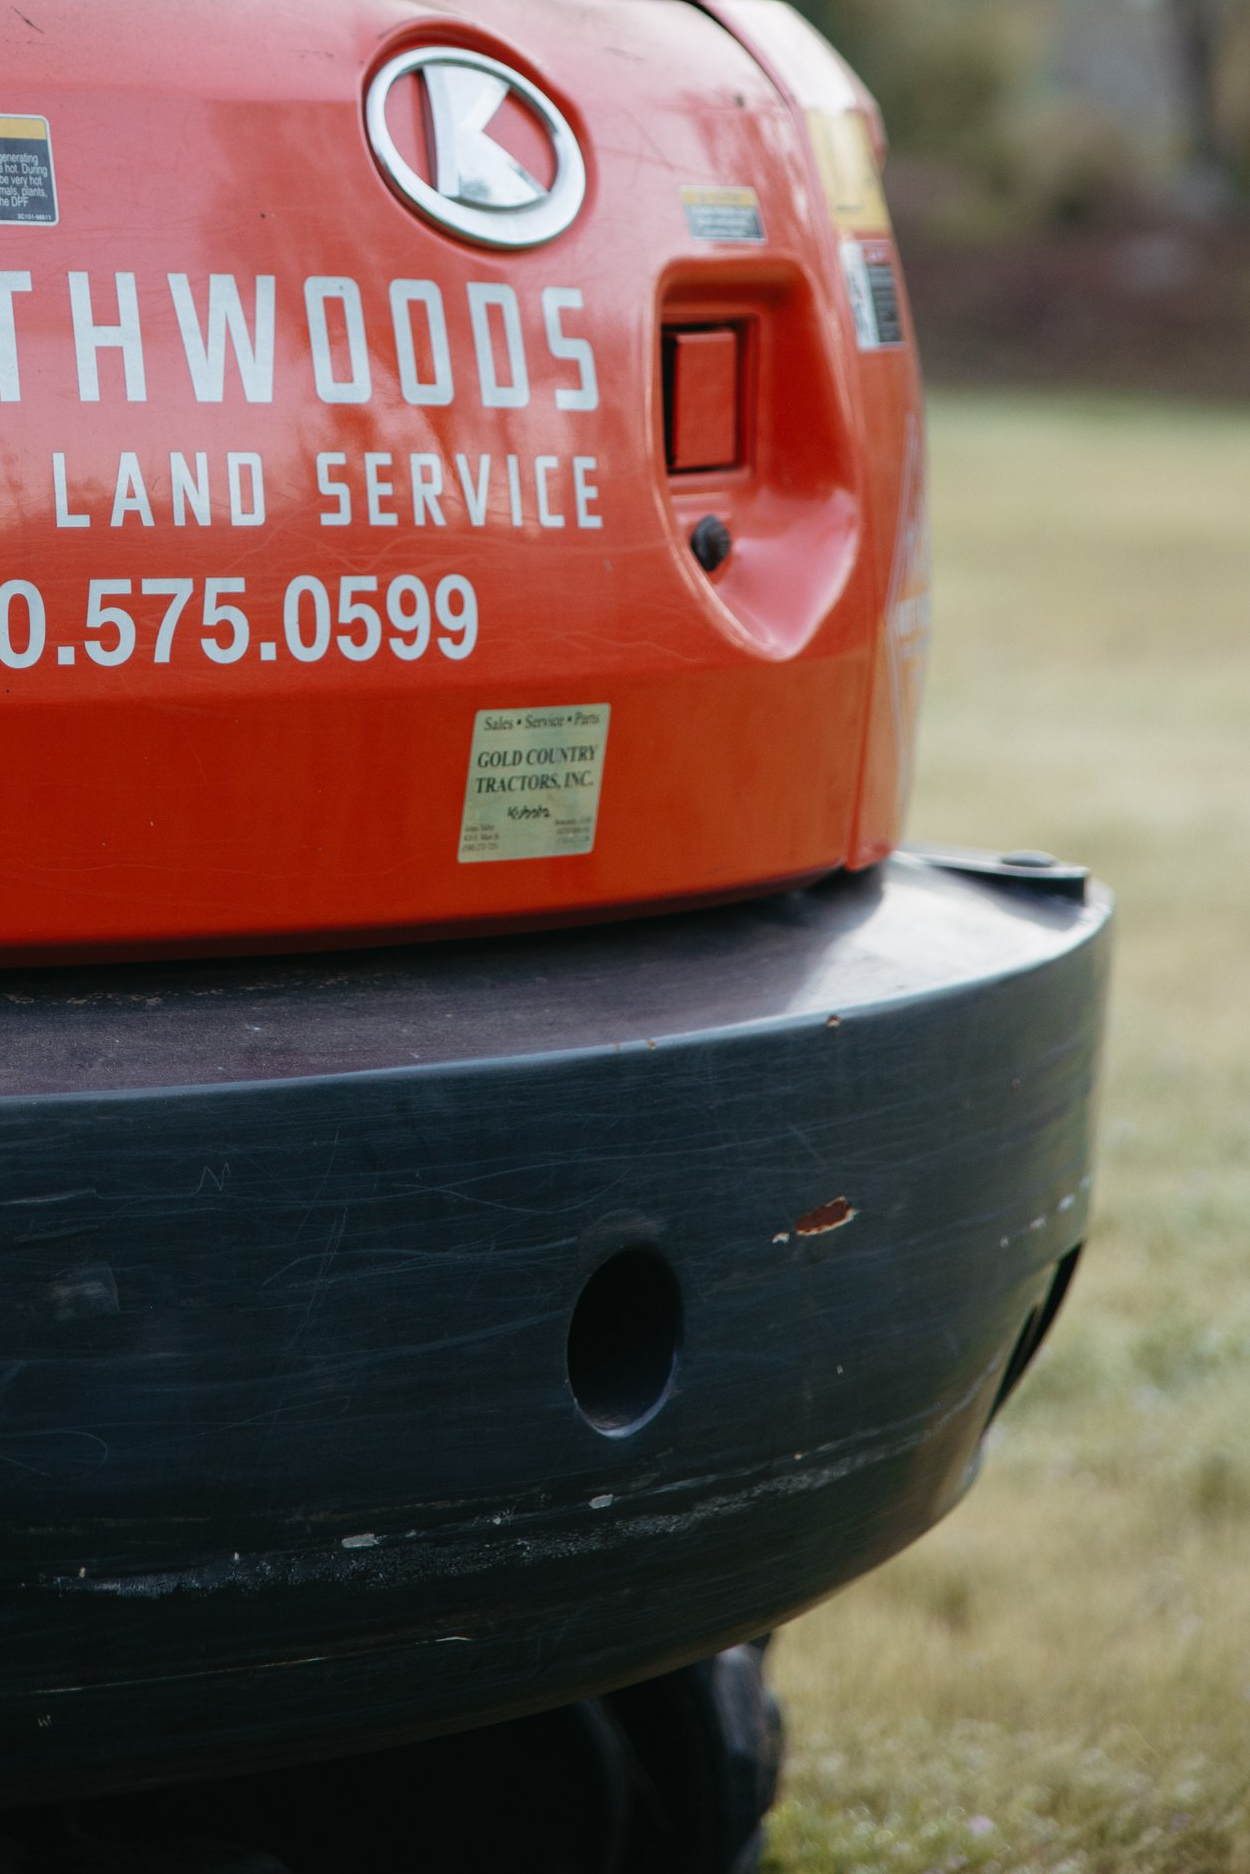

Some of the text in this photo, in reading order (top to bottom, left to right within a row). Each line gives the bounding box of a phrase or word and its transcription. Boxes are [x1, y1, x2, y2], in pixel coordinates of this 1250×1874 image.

[5, 163, 19, 173] hot.
[22, 164, 47, 177] During
[0, 175, 9, 184] be
[11, 176, 28, 185] very
[29, 176, 42, 185] hot
[21, 187, 47, 198] plants,
[11, 196, 29, 207] DPF
[51, 450, 267, 528] LAND
[316, 450, 604, 530] SERVICE
[484, 717, 513, 731] Sales
[524, 715, 564, 729] Service
[477, 745, 598, 768] GOLD COUNTRY
[476, 770, 593, 793] TRACTORS, INC.
